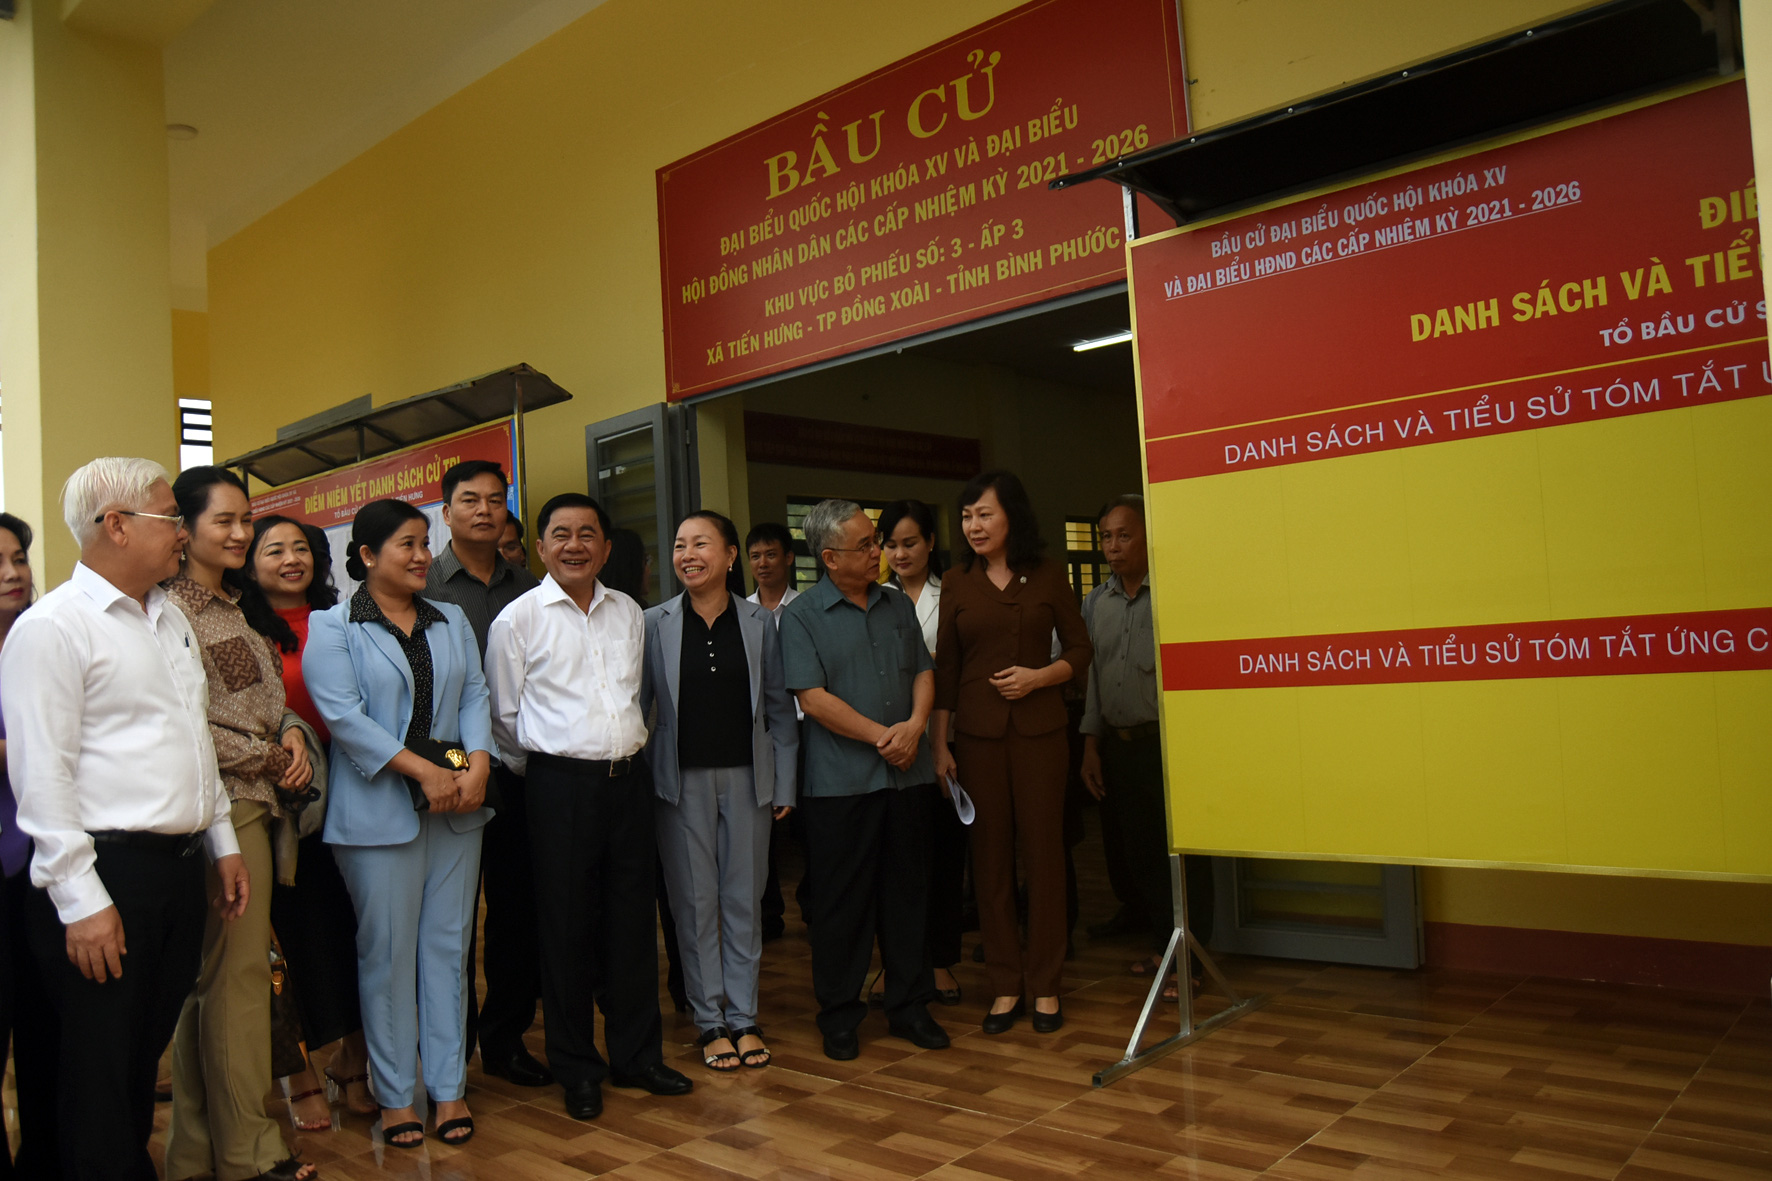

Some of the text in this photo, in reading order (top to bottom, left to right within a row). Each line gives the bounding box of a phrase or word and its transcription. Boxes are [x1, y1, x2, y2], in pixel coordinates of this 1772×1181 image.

[764, 50, 1000, 200] BẦU CỬ
[682, 277, 705, 304] HỘI
[710, 265, 748, 294] ĐỒNG
[753, 248, 793, 279] NHÂN
[798, 234, 831, 263] DÂN
[836, 220, 868, 249] CÁC
[874, 202, 908, 236] CẤP
[915, 183, 976, 223] NHIỆM
[983, 168, 1008, 200] KỲ
[1017, 152, 1069, 189] 2021
[1092, 124, 1148, 164] 2026
[721, 98, 1077, 255] ĐẠI BIỂU QUỐC HỘI KHÓA XV VÀ ĐẠI BIỂU
[1212, 165, 1506, 258] BẦU CỬ ĐẠI BIỂU QUỐC HỘI KHÓA XV
[765, 292, 794, 316] KHU
[799, 280, 829, 305] VỰC
[834, 265, 855, 295] BỎ
[861, 250, 910, 286] PHIẾU
[916, 237, 944, 268] SỐ:
[952, 238, 962, 257] 3
[981, 219, 1005, 249] ẤP
[1012, 219, 1024, 239] 3
[1164, 275, 1183, 298] VÀ
[1187, 272, 1212, 292] ĐẠI
[1216, 256, 1250, 285] BIỂU
[1255, 252, 1297, 277] HĐND
[1302, 241, 1333, 265] CÁC
[1338, 228, 1370, 256] CẤP
[1375, 215, 1431, 247] NHIỆM
[1436, 207, 1458, 233] KỲ
[1467, 198, 1512, 225] 2021
[1532, 181, 1580, 210] 2026
[707, 342, 724, 365] XÃ
[728, 334, 759, 358] TIẾN
[764, 321, 803, 348] HƯNG
[817, 311, 836, 332] TP
[841, 295, 885, 325] ĐỒNG
[891, 280, 930, 311] XOÀI
[947, 264, 989, 293] TỈNH
[997, 249, 1042, 280] BÌNH
[1050, 226, 1120, 265] PHƯỚC
[1411, 298, 1499, 342] DANH
[1512, 276, 1607, 321] SÁCH
[1620, 257, 1672, 300] VÀ
[1600, 318, 1632, 346] TỔ
[1641, 311, 1694, 340] BẦU
[1705, 300, 1747, 328] CỬ
[1225, 436, 1296, 464] DANH
[1307, 422, 1383, 452] SÁCH
[1394, 410, 1433, 438] VÀ
[1443, 395, 1514, 431] TIỂU
[1528, 386, 1571, 419] SỬ
[1582, 378, 1659, 410] TÓM
[1672, 360, 1746, 396] TẮT
[305, 485, 325, 515] ĐIỂM
[350, 474, 367, 502] YẾT
[369, 474, 395, 498] DANH
[397, 464, 424, 491] SÁCH
[426, 453, 441, 484] CỬ
[1240, 653, 1299, 673] DANH
[1308, 646, 1370, 671] SÁCH
[1379, 642, 1411, 667] VÀ
[1419, 634, 1476, 665] TIỂU
[1486, 634, 1520, 663] SỬ
[1529, 633, 1589, 660] TÓM
[1600, 626, 1656, 657] TẮT
[1667, 626, 1734, 655] ỨNG
